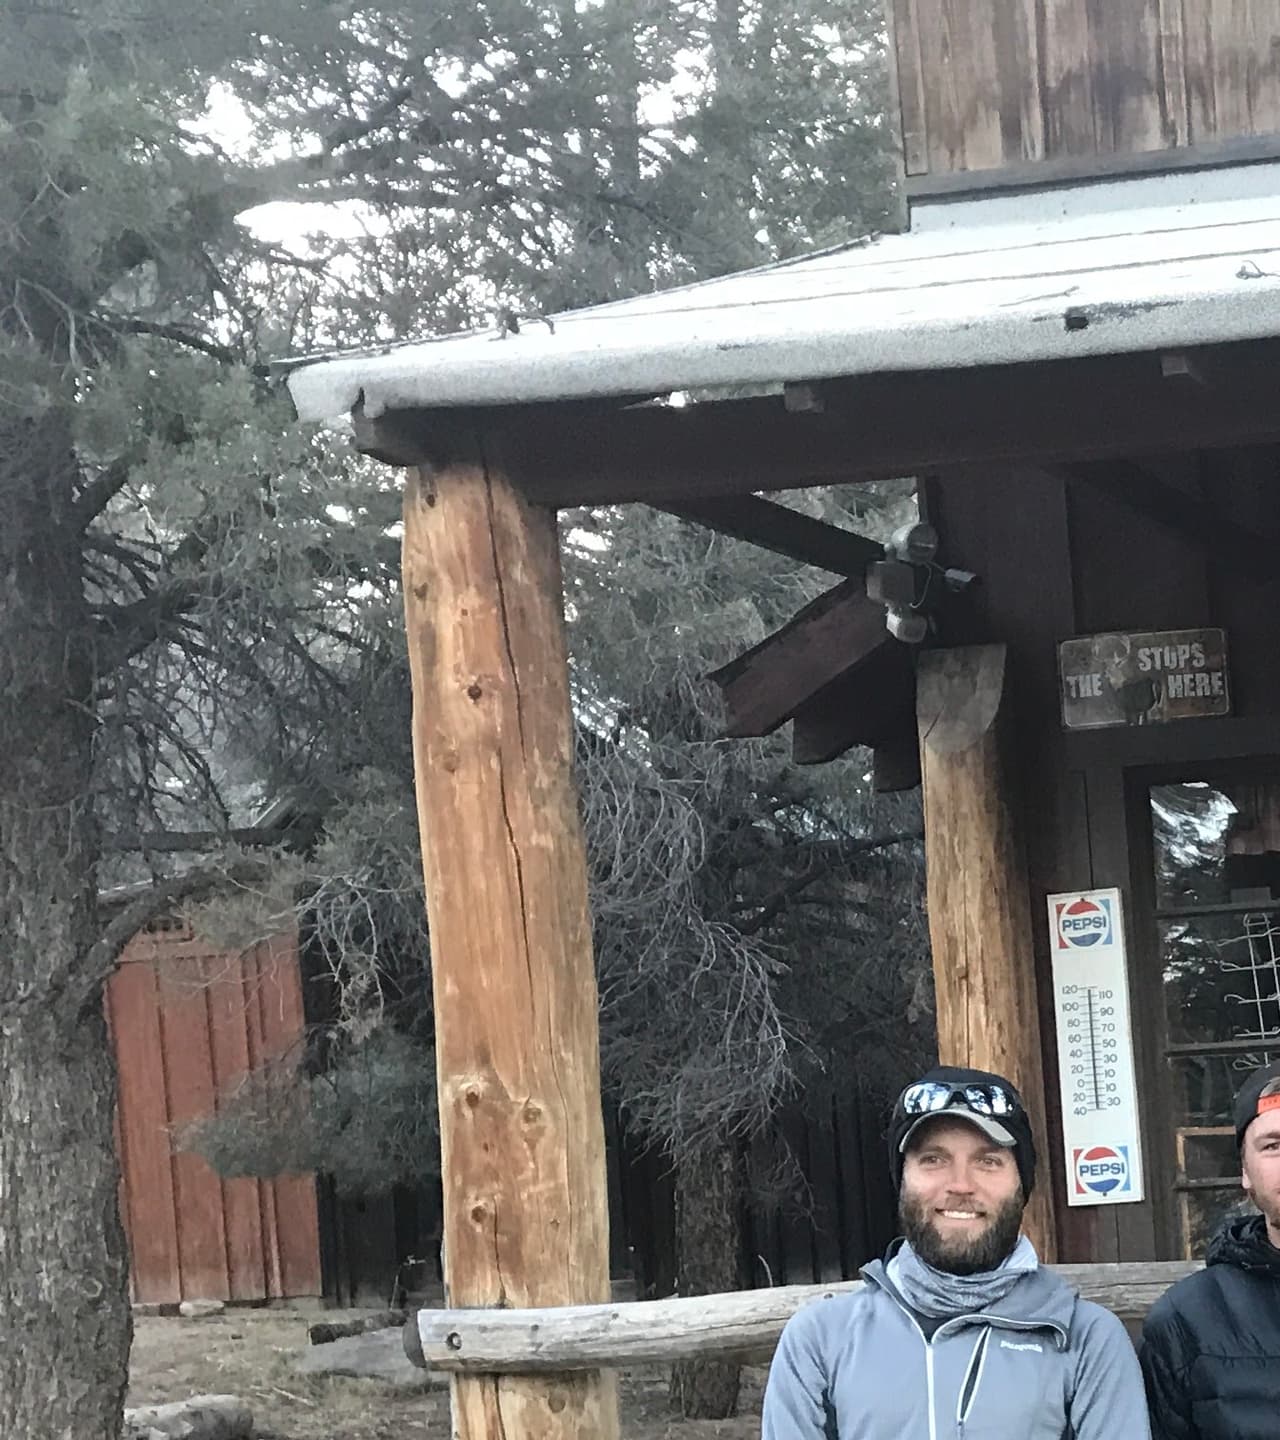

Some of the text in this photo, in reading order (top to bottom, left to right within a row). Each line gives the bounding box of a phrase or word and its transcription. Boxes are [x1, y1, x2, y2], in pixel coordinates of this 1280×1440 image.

[1137, 643, 1206, 671] STOPS
[1066, 673, 1103, 699] THE
[1167, 672, 1224, 699] HERE
[1062, 915, 1107, 931] PEPSI
[1062, 985, 1078, 995] 120
[1099, 990, 1113, 999] 110
[1062, 1002, 1079, 1012] 100
[1100, 1007, 1114, 1016] 90
[1101, 1023, 1115, 1032] 70
[1068, 1034, 1081, 1043] 60
[1102, 1039, 1116, 1048] 50
[1069, 1049, 1083, 1058] 40
[1103, 1054, 1118, 1063] 30
[1071, 1064, 1084, 1074] 20
[1104, 1069, 1116, 1078] 10
[1077, 1079, 1085, 1088] 0
[1105, 1083, 1117, 1092] 10
[1073, 1092, 1086, 1102] 20
[1107, 1096, 1121, 1106] 30
[1074, 1106, 1087, 1116] 40
[1079, 1162, 1125, 1177] PEPSI
